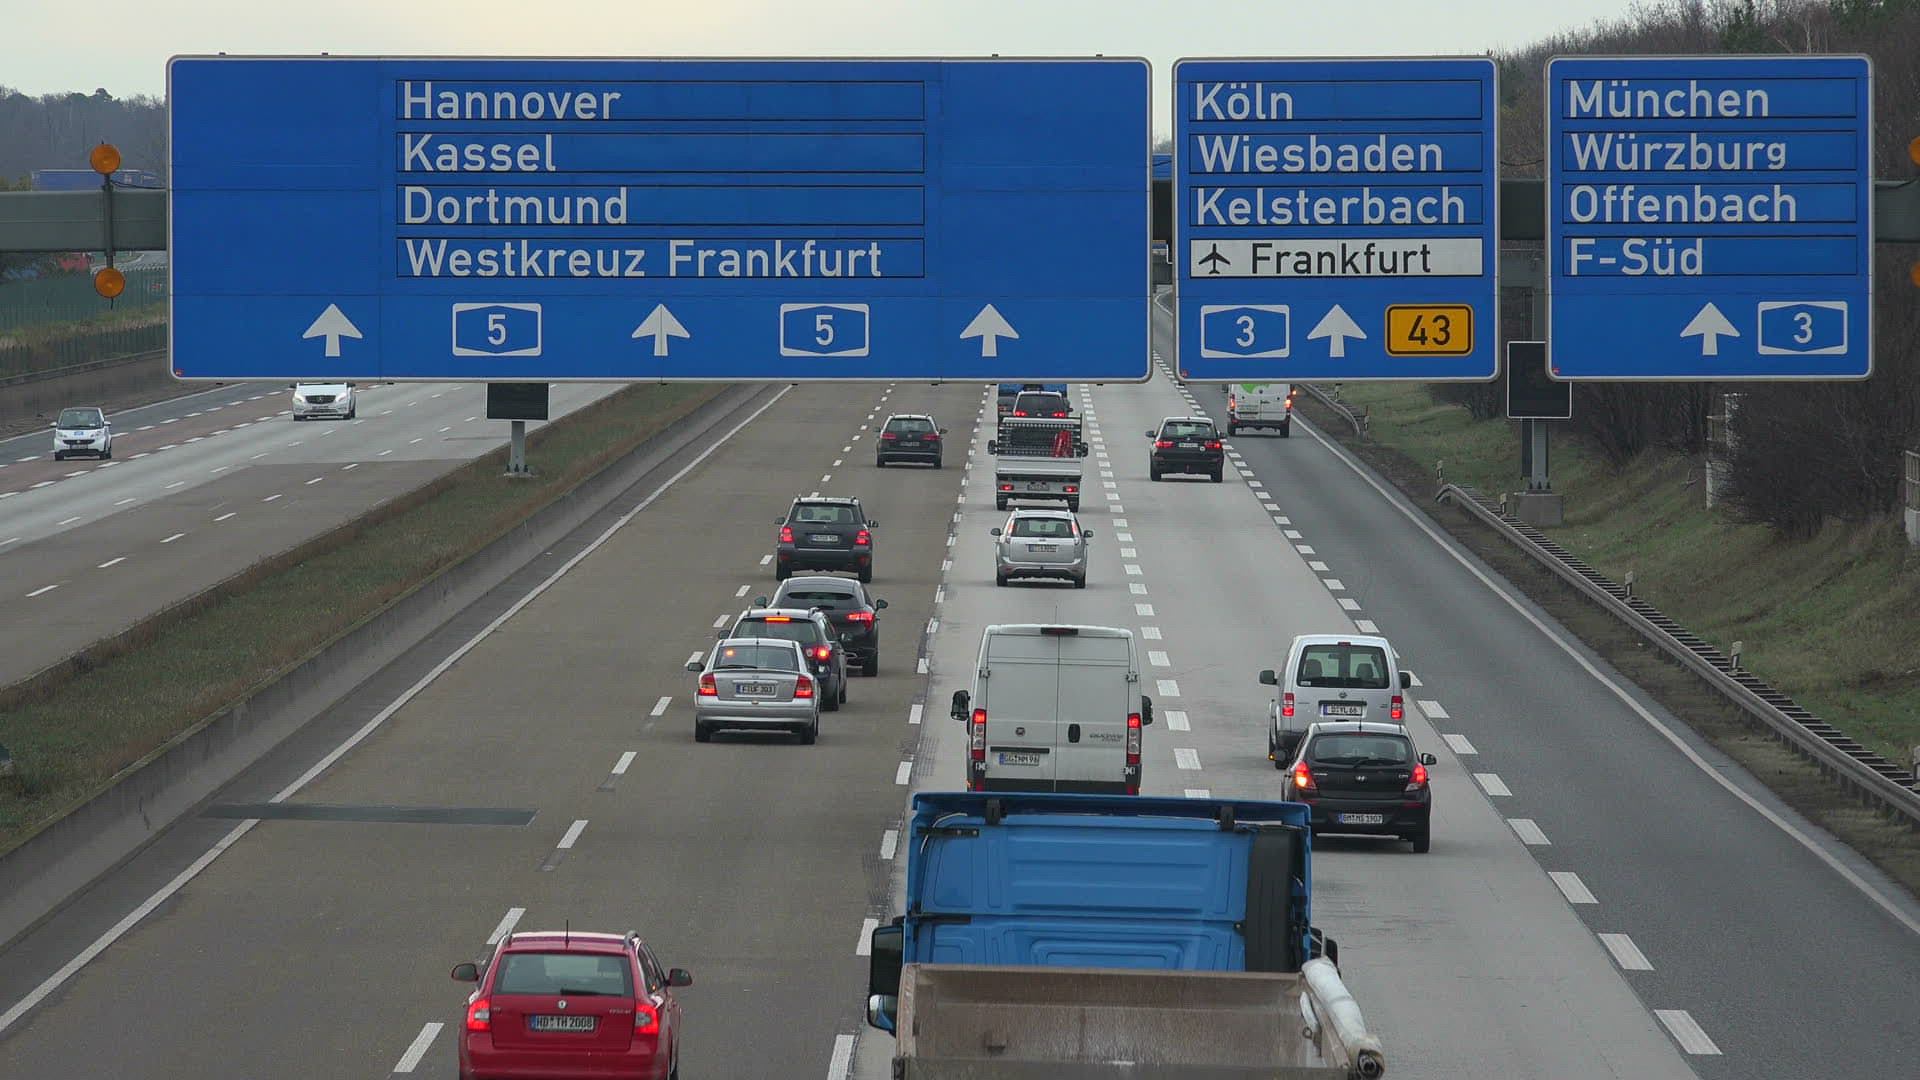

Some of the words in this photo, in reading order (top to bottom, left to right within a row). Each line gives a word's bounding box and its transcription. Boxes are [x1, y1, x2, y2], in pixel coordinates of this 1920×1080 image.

[404, 82, 622, 120] Hannover
[1196, 82, 1293, 120] Köln
[1570, 80, 1769, 118] München
[404, 134, 556, 172] Kassel
[1197, 134, 1442, 173] Wiesbaden
[1570, 132, 1786, 171] Würzburg
[404, 187, 627, 224] Dortmund
[1197, 187, 1465, 225] Kelsterbach
[1570, 185, 1796, 223] Offenbach
[405, 239, 645, 277] Westkreuz
[669, 240, 882, 277] Frankfurt
[1251, 243, 1431, 275] Frankfurt
[1570, 238, 1703, 276] F-Süd
[488, 313, 506, 345] 5
[815, 314, 834, 346] 5
[1236, 315, 1255, 347] 3
[1407, 314, 1451, 346] 43
[1793, 311, 1813, 344] 3
